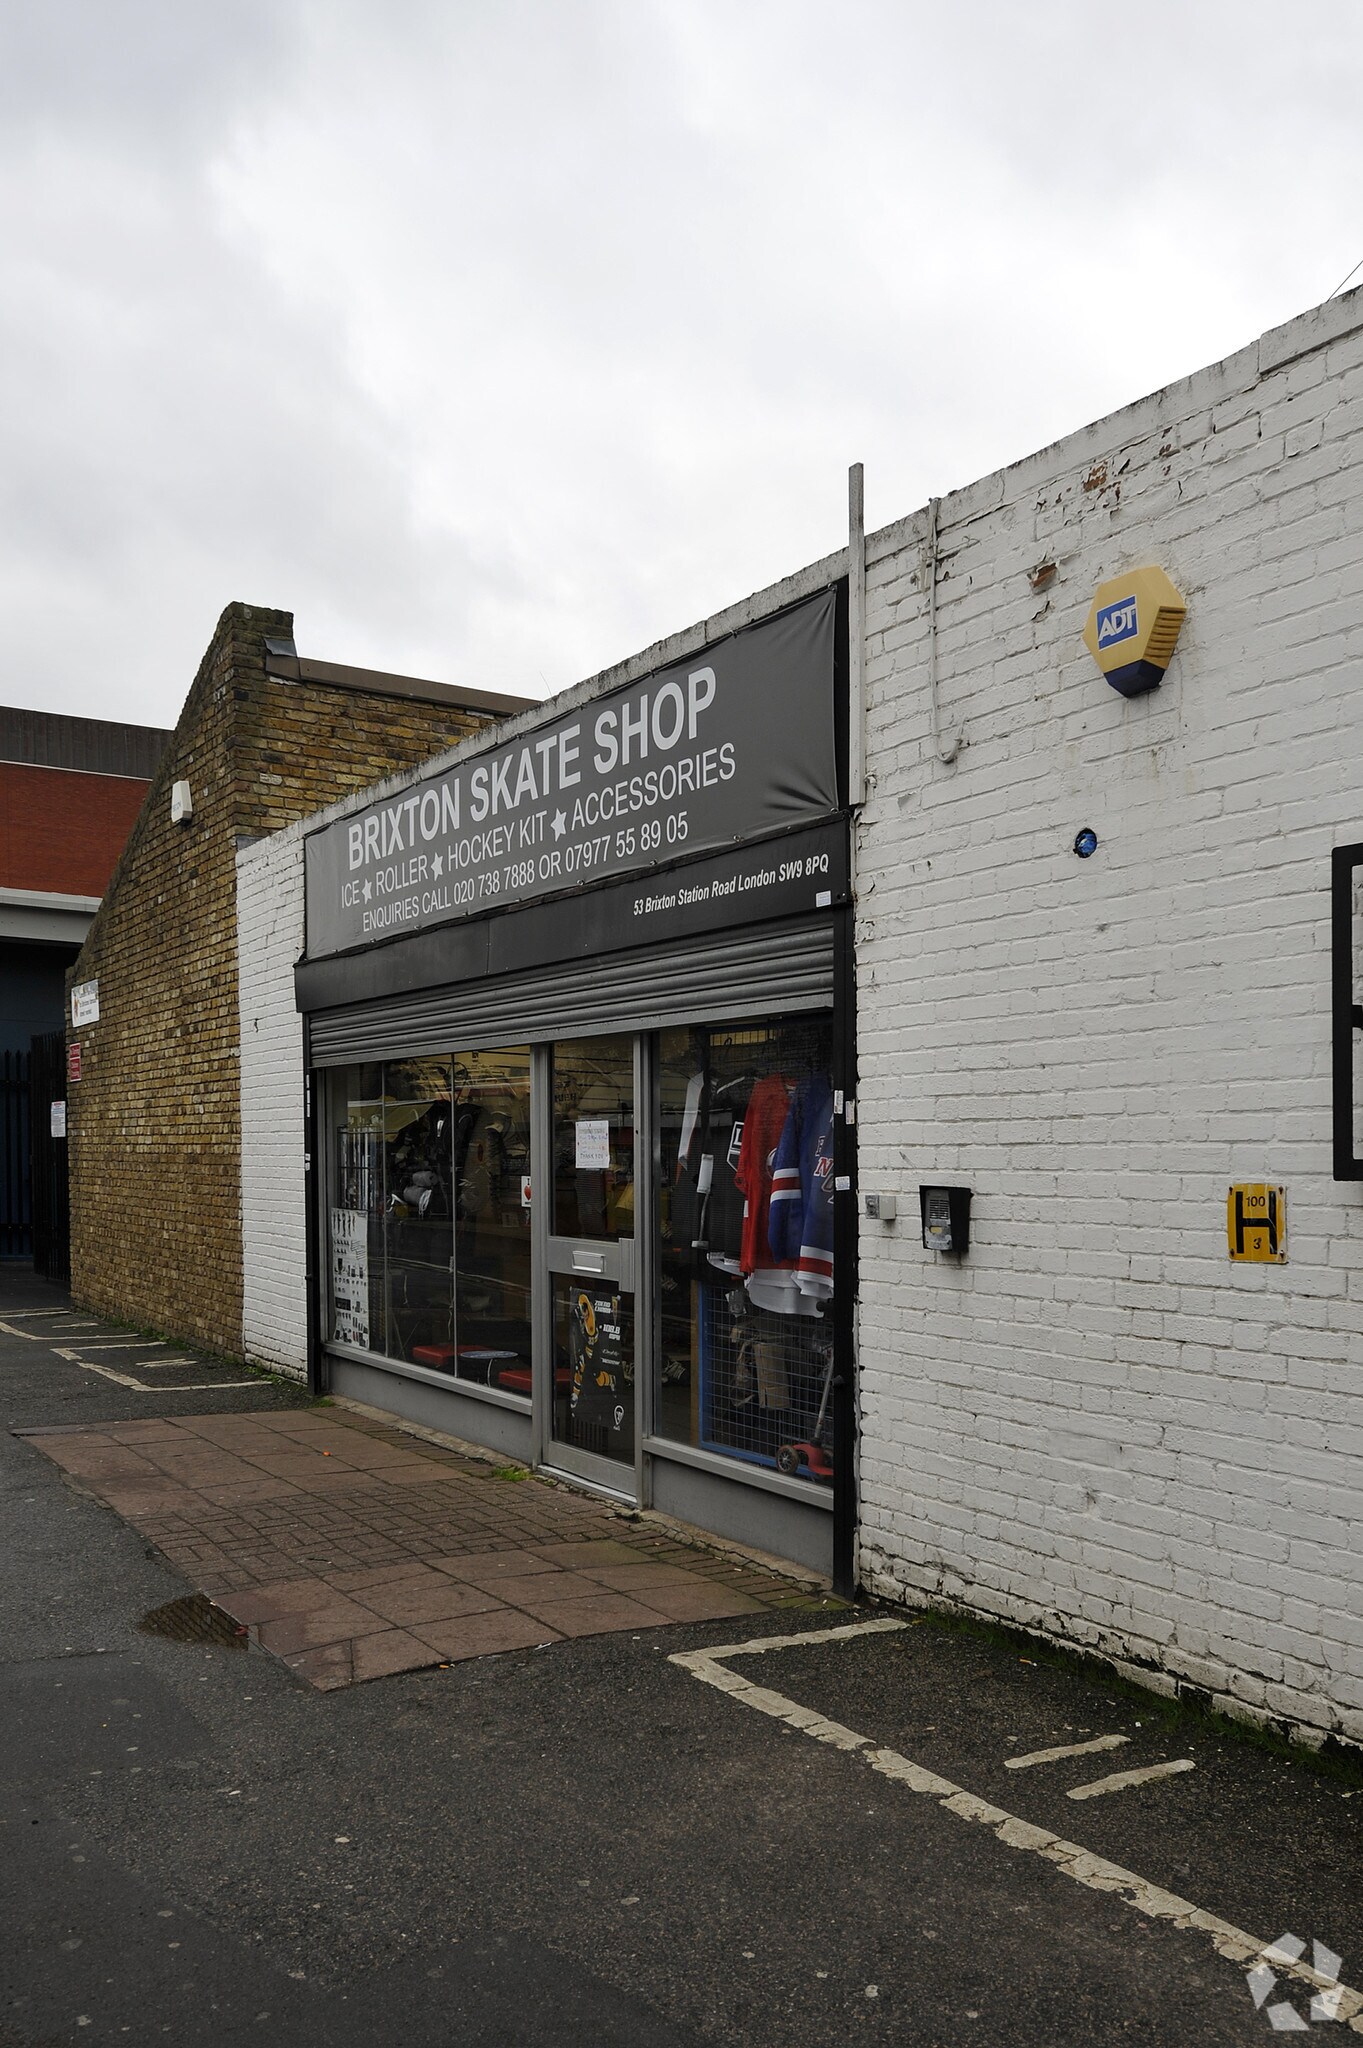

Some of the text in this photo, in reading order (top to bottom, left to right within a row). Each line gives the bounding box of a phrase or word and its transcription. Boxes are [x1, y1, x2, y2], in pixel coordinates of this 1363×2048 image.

[1098, 605, 1136, 641] ADT
[348, 666, 717, 871] BRIXTON SKATE SHOP
[341, 742, 736, 909] ICE ROLLER HOCKEY KIT ACCESSORIES
[363, 810, 688, 932] ENQUIRIES CALL 020 738 7888 OR 07977 55 89 05
[633, 853, 829, 916] 53 Brixton Station Road London SW9 8PQ
[1236, 1190, 1277, 1254] H
[1246, 1196, 1266, 1207] 100
[1253, 1237, 1261, 1249] 3
